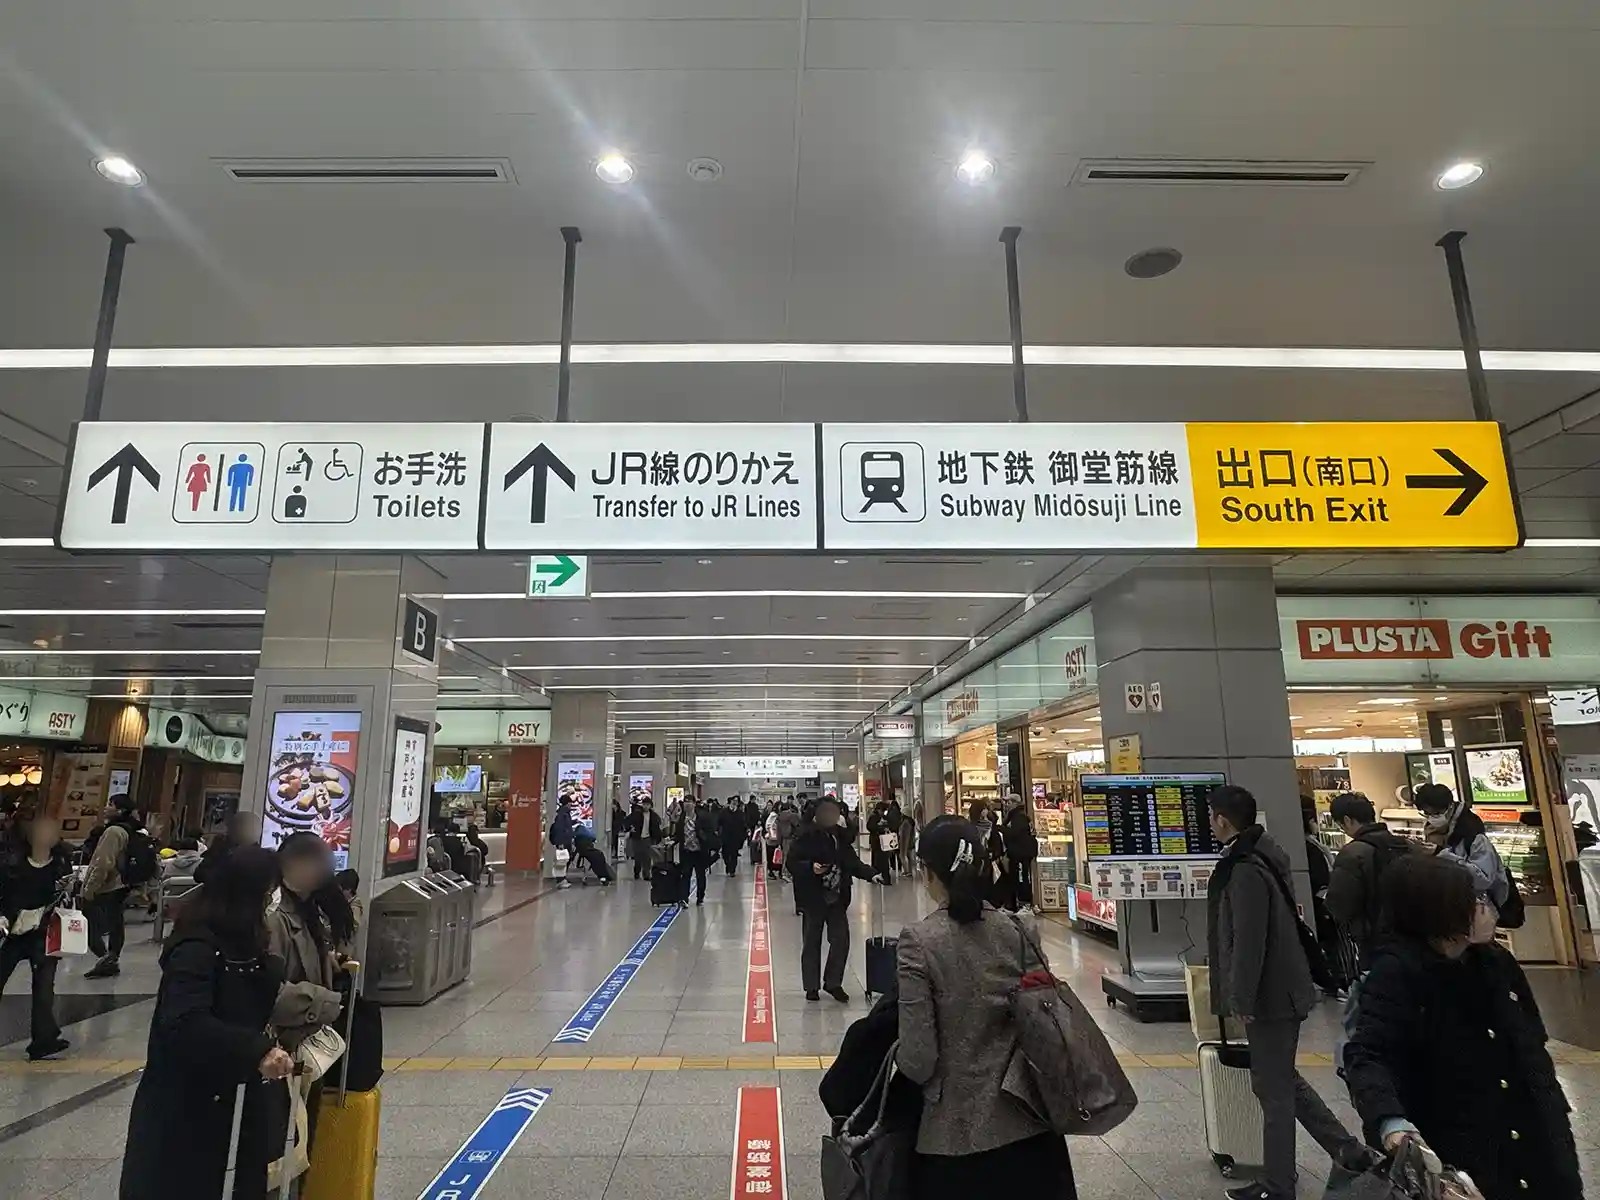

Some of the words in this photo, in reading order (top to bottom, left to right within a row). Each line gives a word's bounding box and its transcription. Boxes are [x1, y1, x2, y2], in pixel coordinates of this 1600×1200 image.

[374, 451, 466, 486] お手洗
[592, 451, 798, 486] JR線のりかえ
[938, 451, 1034, 485] 地下鉄
[1049, 450, 1178, 485] 御堂筋線
[373, 495, 460, 517] Toilets
[593, 495, 677, 517] Transfer
[685, 496, 703, 517] to
[712, 495, 736, 517] JR
[747, 495, 800, 517] Lines
[941, 494, 1025, 522] Subway
[1035, 494, 1126, 522] Midōsuji
[1135, 494, 1181, 517] Line
[1222, 497, 1314, 522] South
[1326, 498, 1389, 522] Exit
[414, 611, 427, 651] B
[1309, 627, 1440, 652] PLUSTA
[1460, 621, 1552, 658] Gift
[1065, 645, 1087, 679] ASTY
[1127, 685, 1143, 693] AED
[0, 702, 29, 722] ぐり
[49, 712, 76, 729] ASTY
[508, 723, 540, 737] ASTY
[637, 745, 648, 757] C
